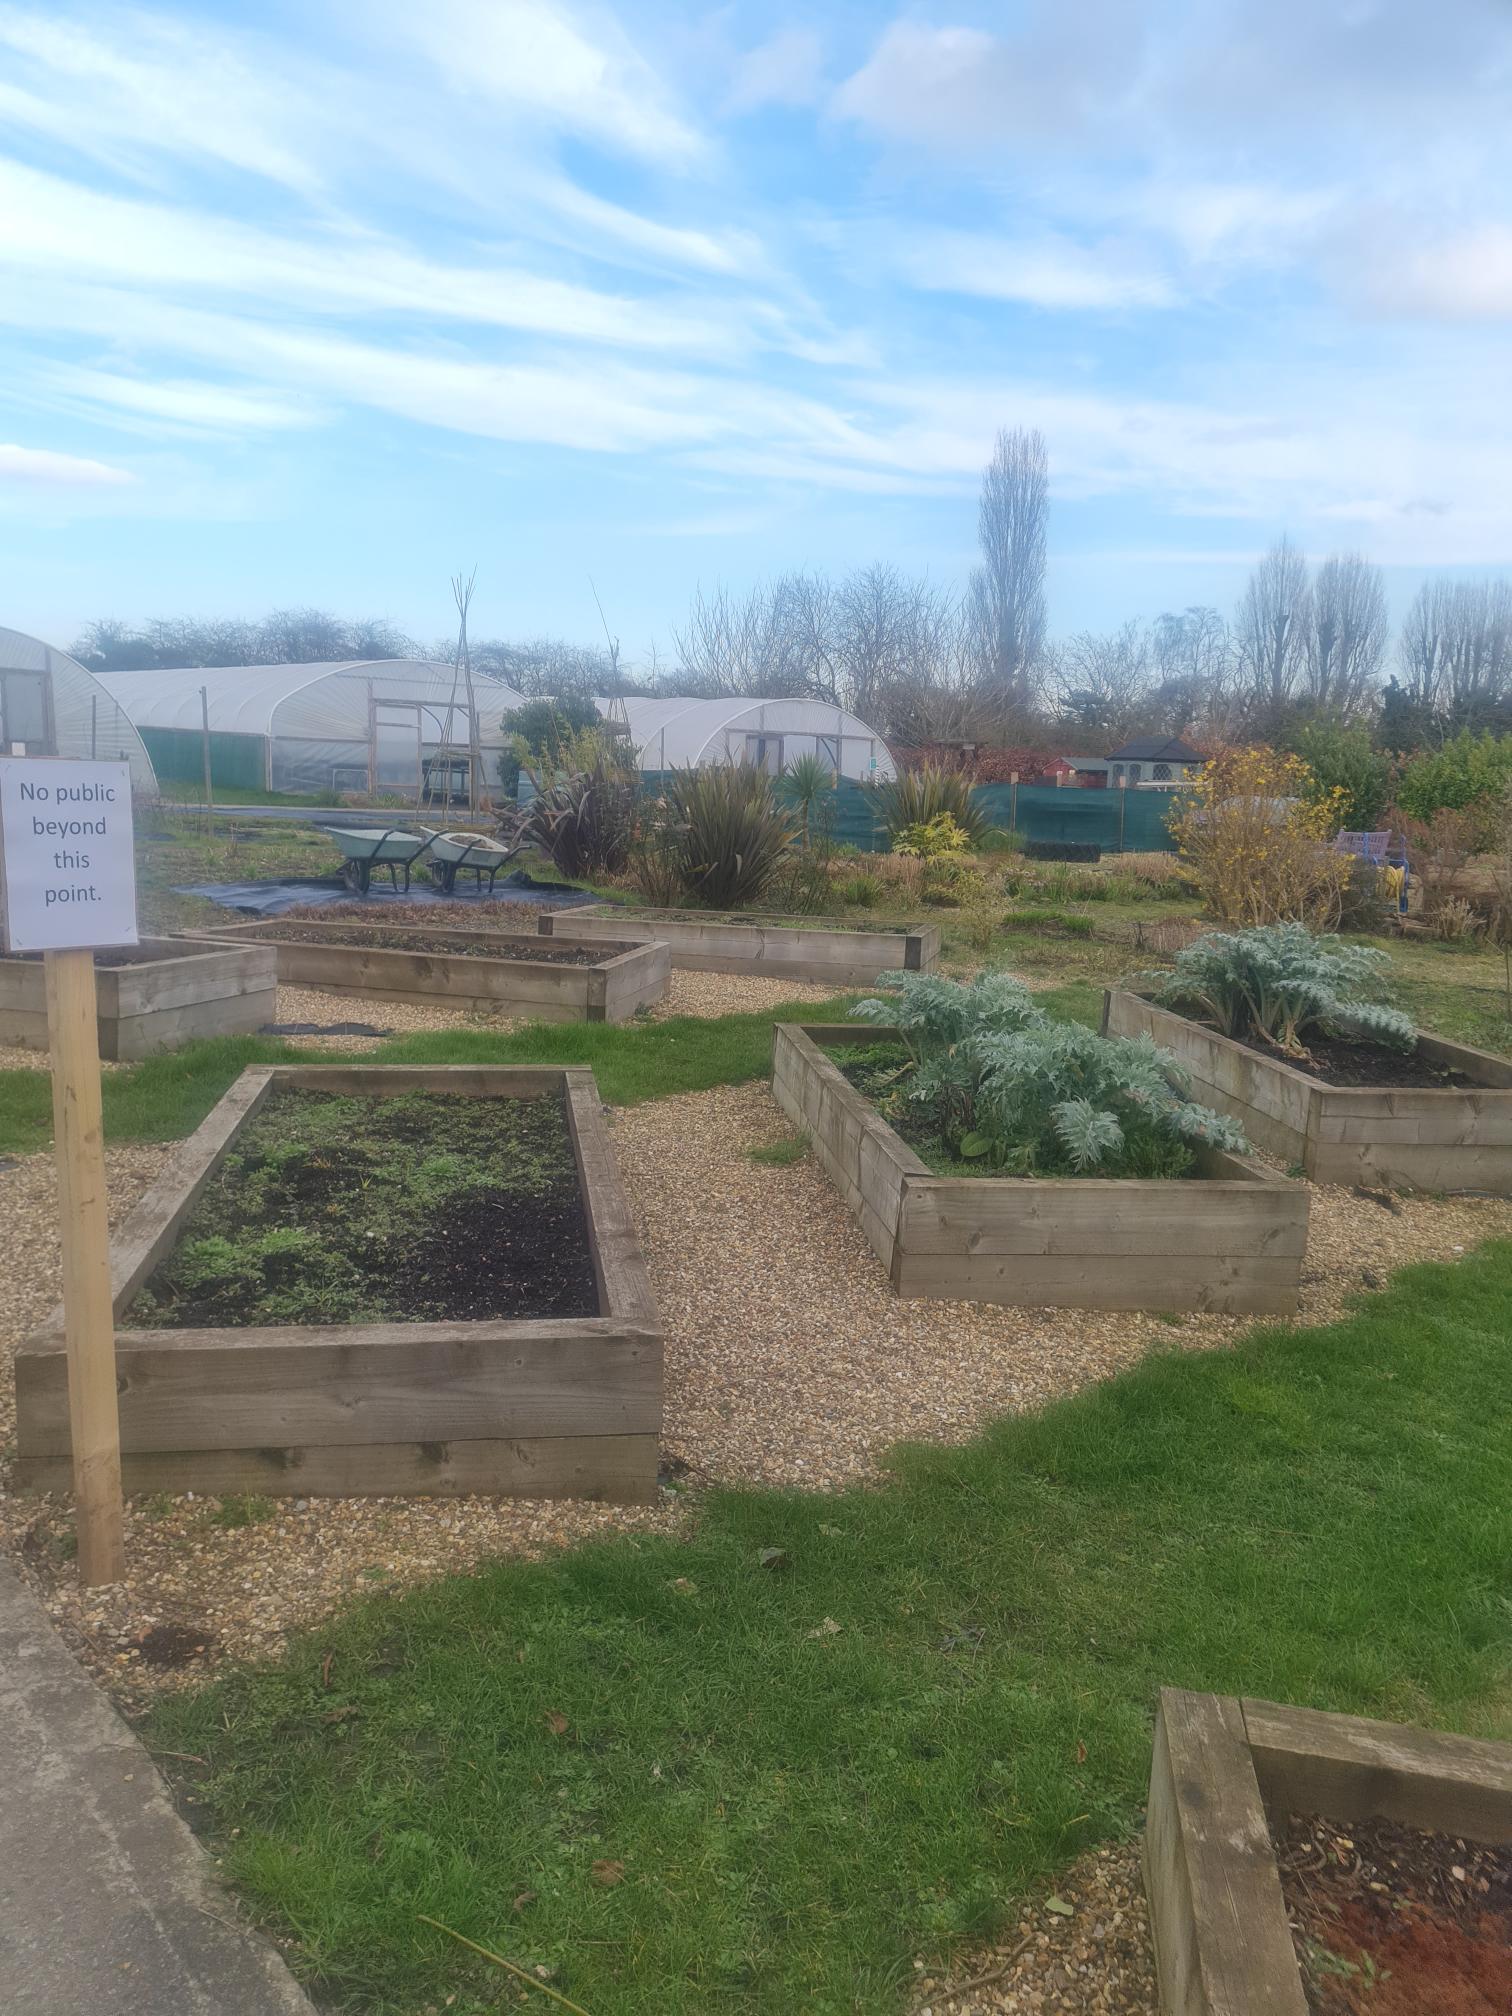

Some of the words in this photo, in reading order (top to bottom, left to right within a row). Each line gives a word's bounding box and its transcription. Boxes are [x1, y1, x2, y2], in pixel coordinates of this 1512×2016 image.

[20, 783, 49, 801] No
[56, 783, 116, 805] public
[32, 816, 107, 839] beyond
[53, 850, 90, 869] this
[45, 885, 102, 907] point.
